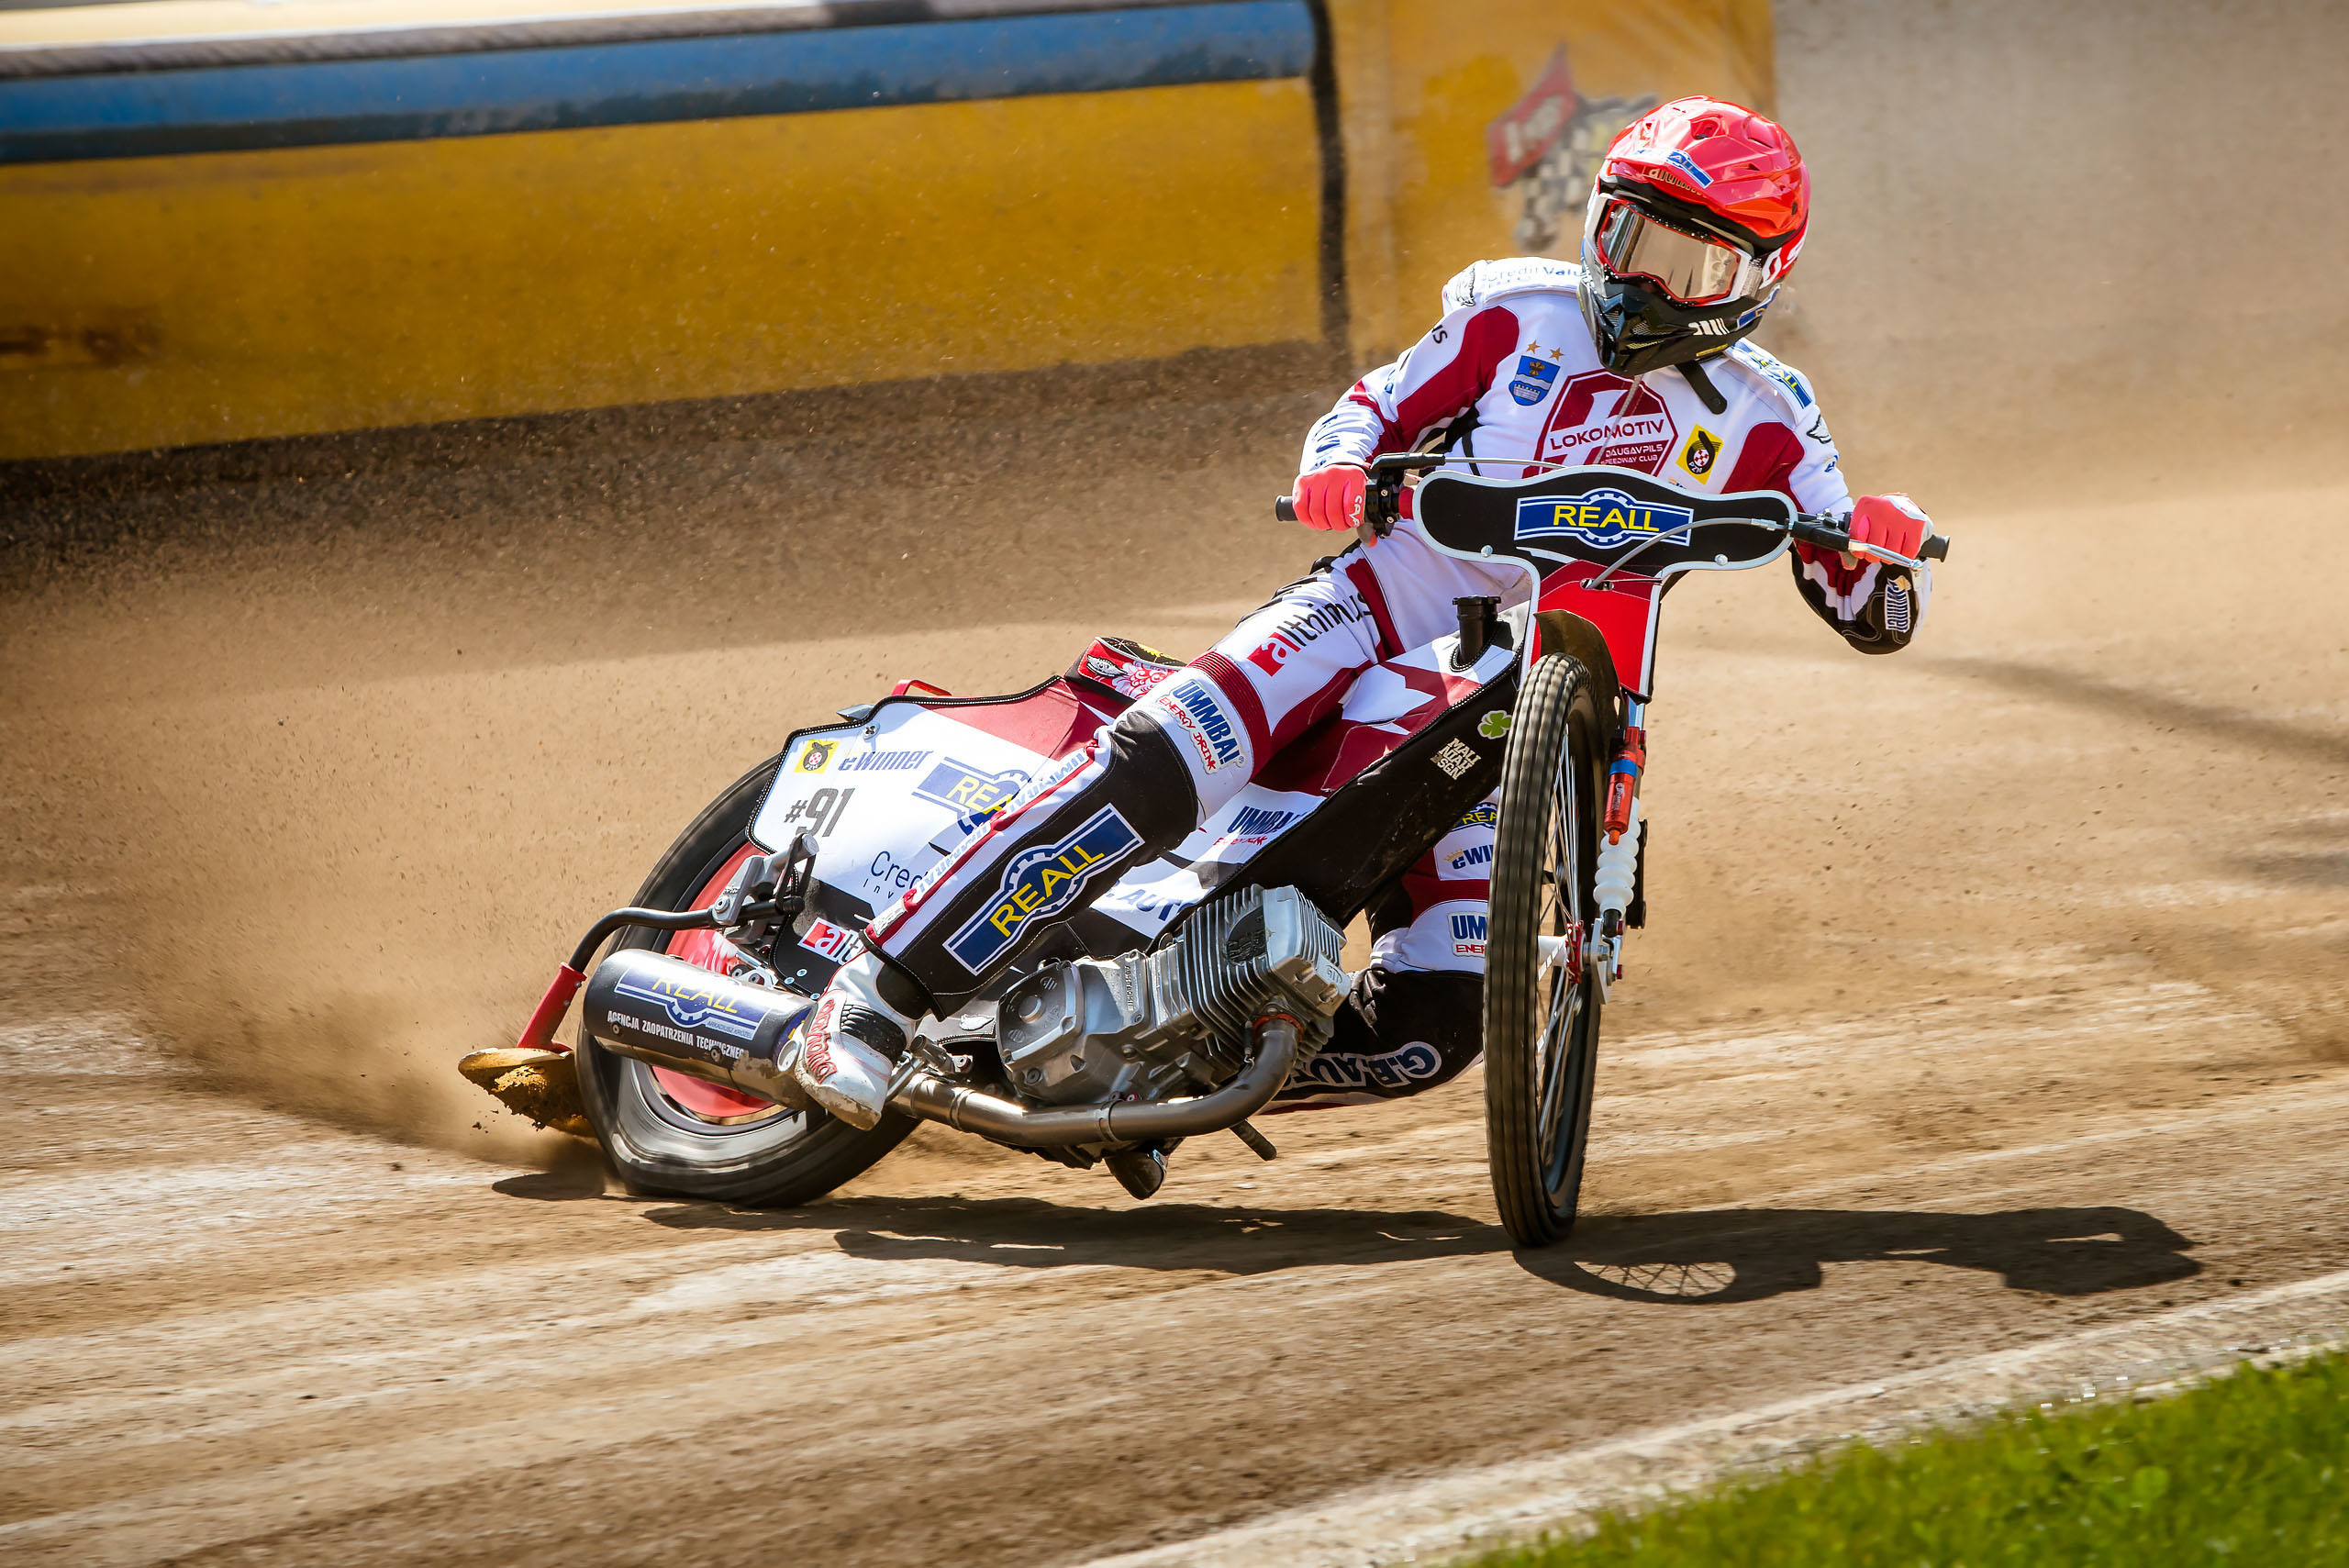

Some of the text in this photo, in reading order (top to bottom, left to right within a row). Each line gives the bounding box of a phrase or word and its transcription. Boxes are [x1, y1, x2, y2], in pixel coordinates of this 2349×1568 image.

[1542, 267, 1585, 277] Valu
[1550, 418, 1664, 450] LOKOMOTIV
[1606, 443, 1664, 458] DAUGAVPILS
[1639, 454, 1658, 463] CLUB
[1553, 504, 1660, 532] REALL
[1159, 696, 1217, 771] ENERGY DRINK
[1173, 681, 1241, 765] UMMBA!
[946, 774, 1016, 815] REA
[1462, 811, 1497, 825] REA
[989, 844, 1105, 938] REALL
[1452, 915, 1487, 940] UM
[642, 1019, 694, 1047] ZAOPATRZENIA
